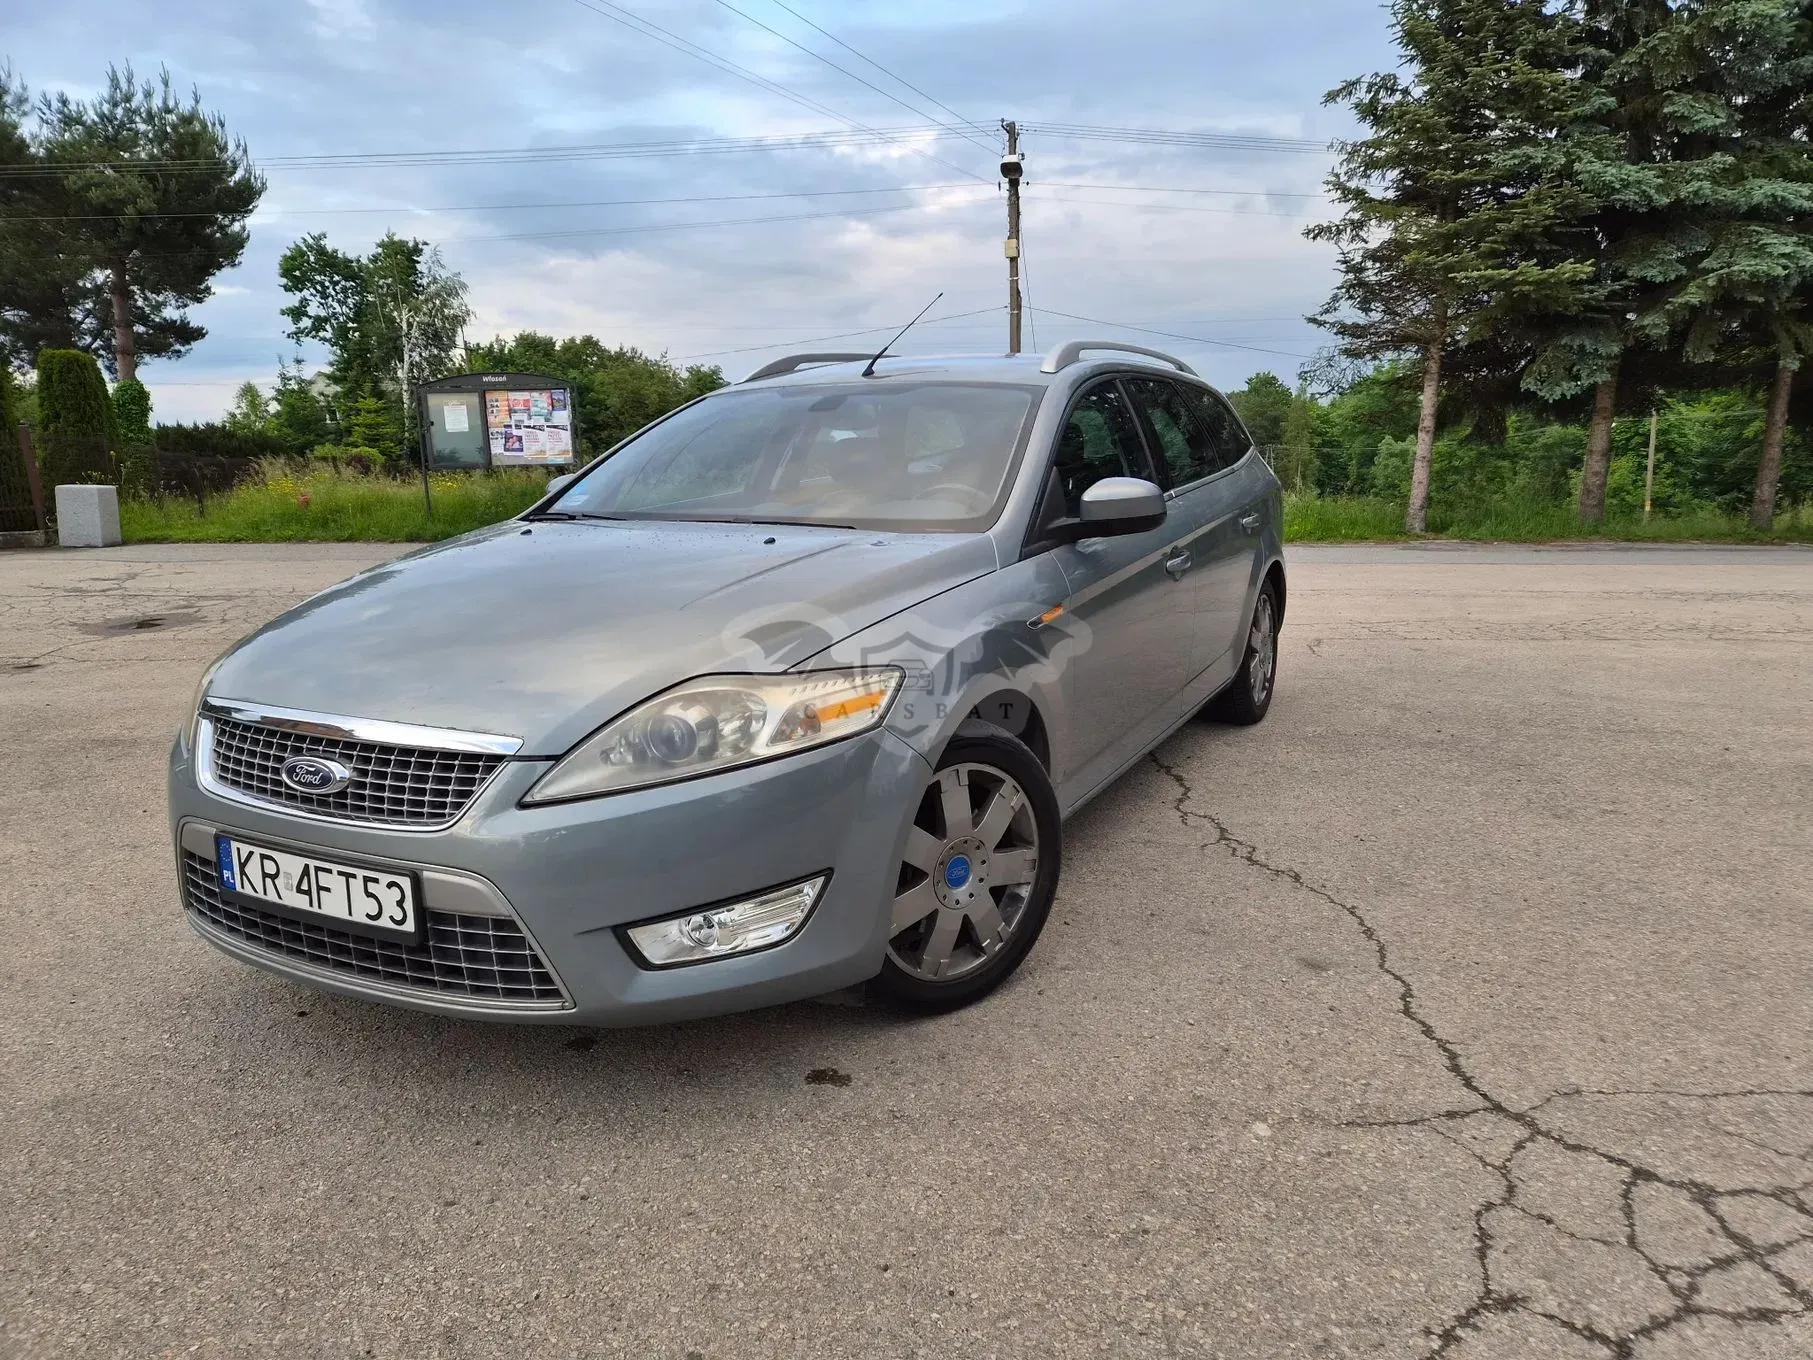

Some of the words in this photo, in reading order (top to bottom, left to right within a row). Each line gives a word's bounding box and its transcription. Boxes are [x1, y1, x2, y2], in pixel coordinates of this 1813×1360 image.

[292, 764, 323, 785] Ford
[223, 870, 235, 884] PL
[236, 846, 283, 901] KR
[295, 863, 408, 926] 4FT53
